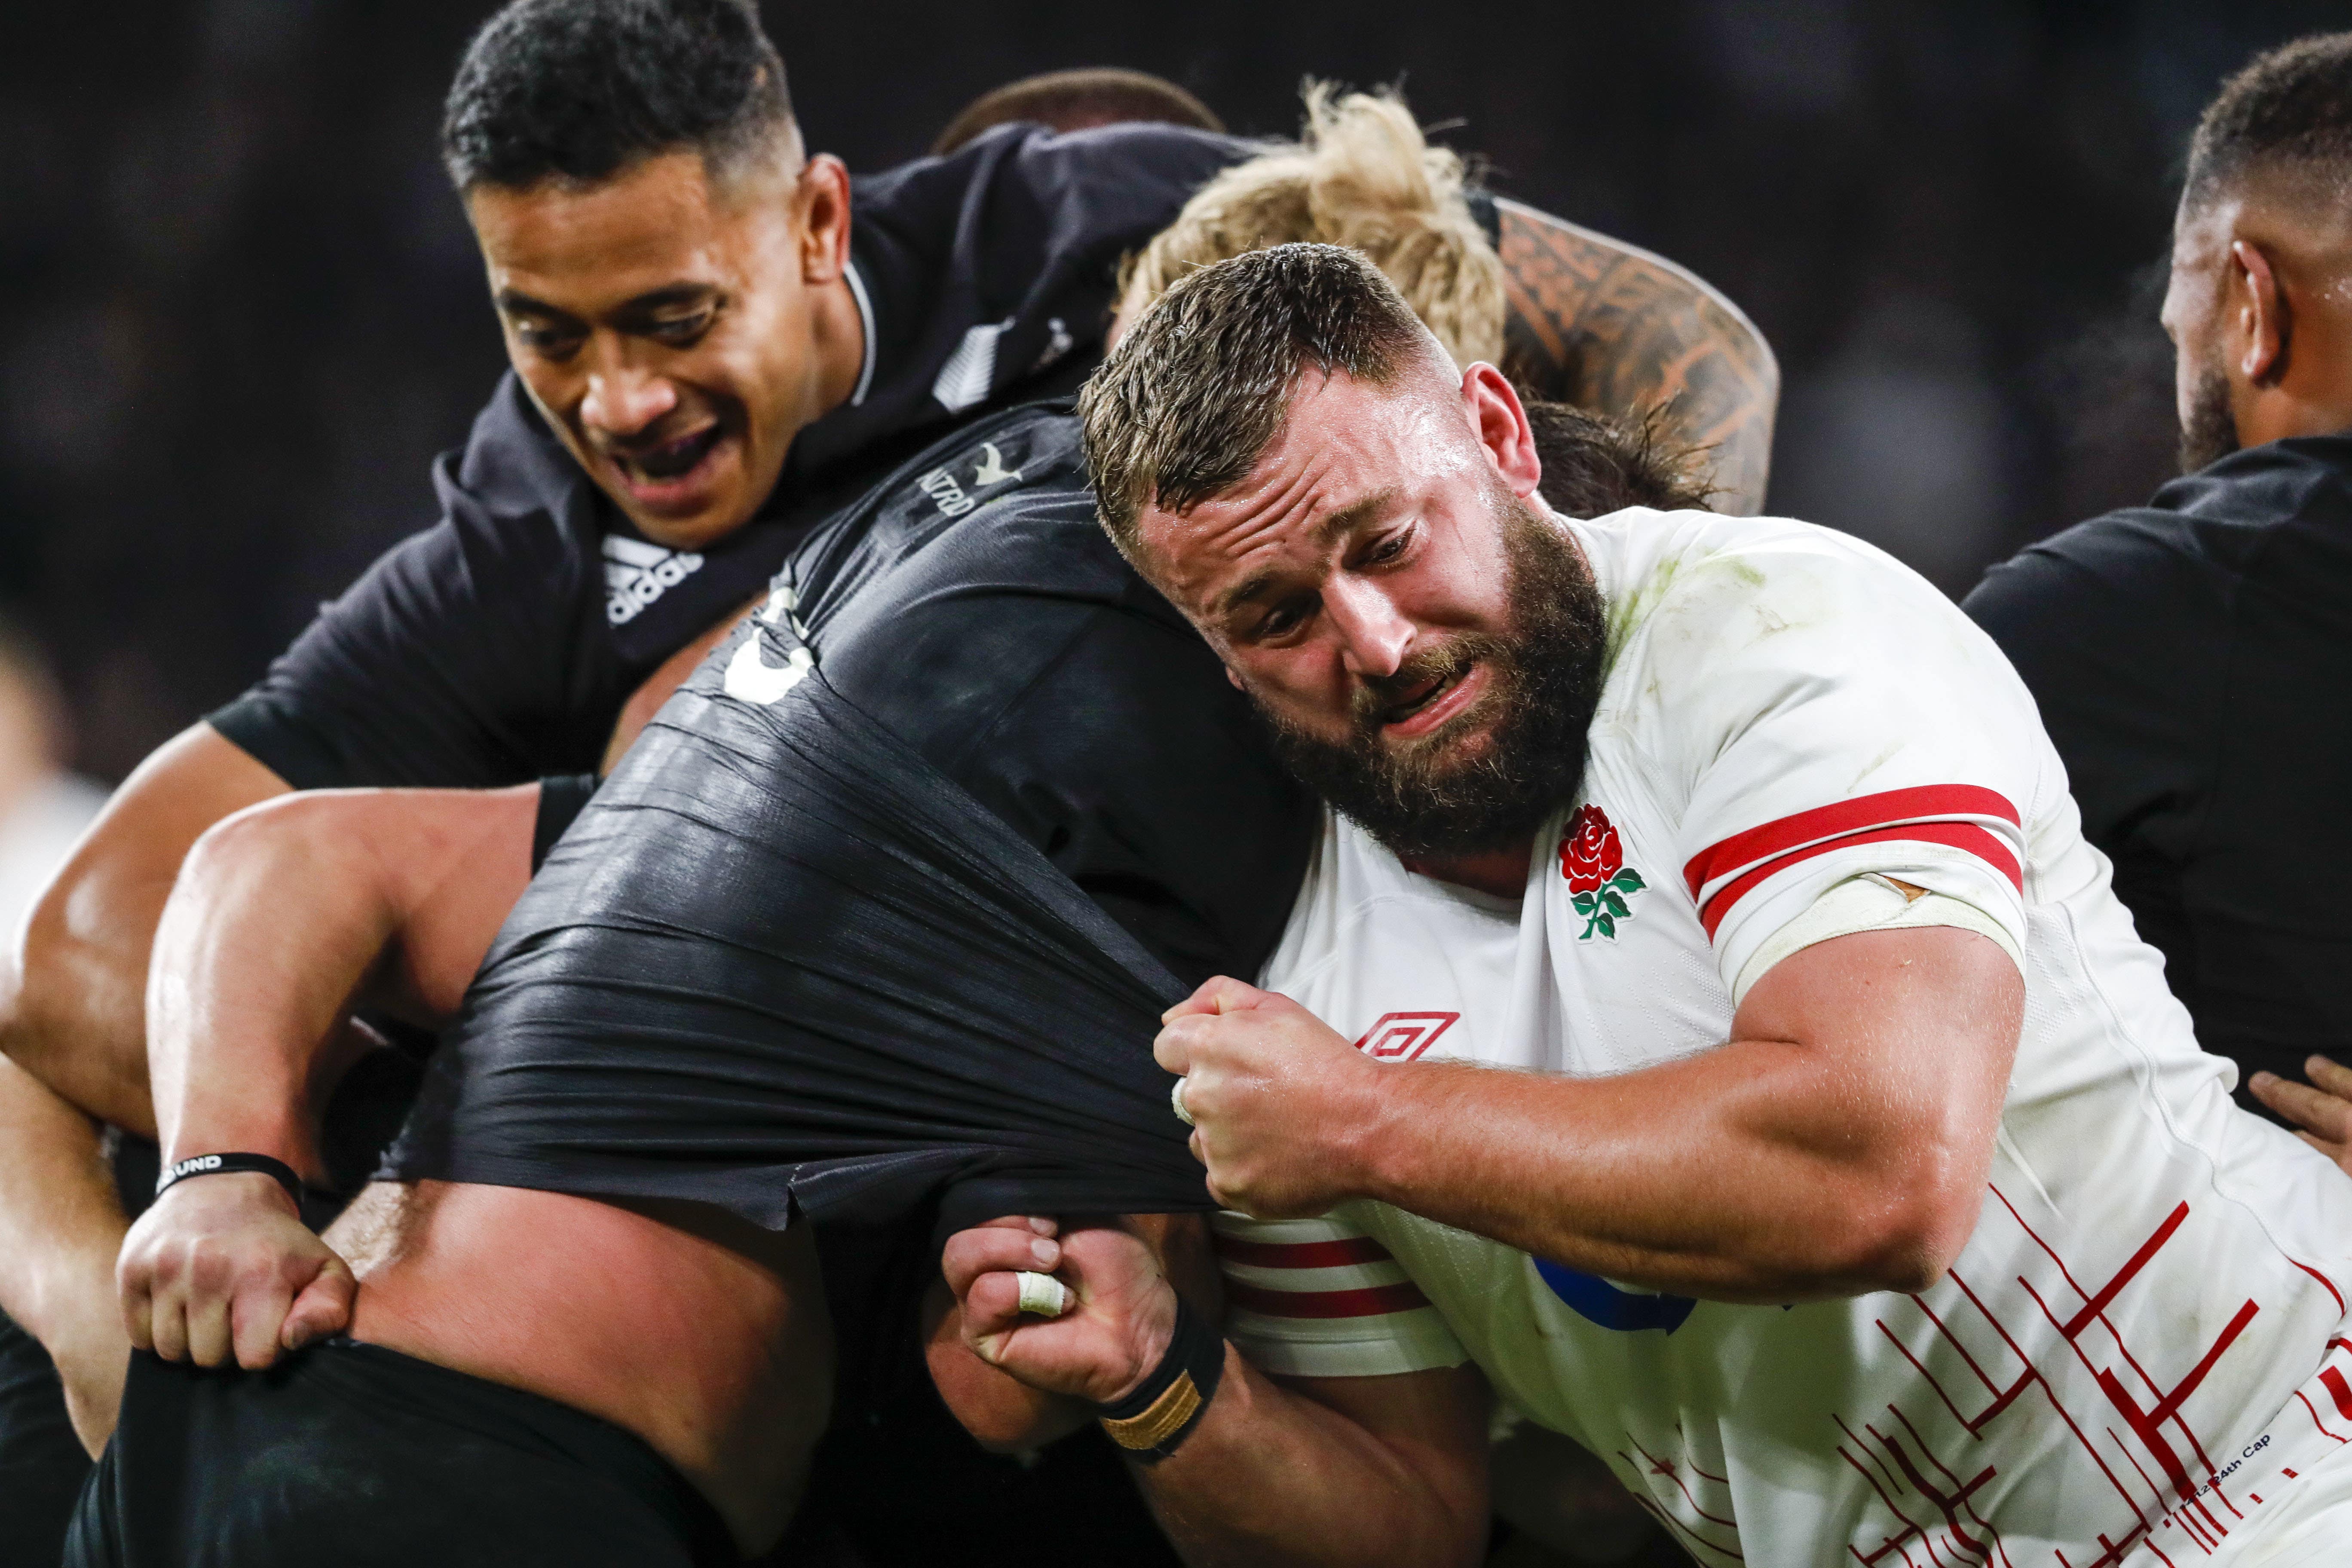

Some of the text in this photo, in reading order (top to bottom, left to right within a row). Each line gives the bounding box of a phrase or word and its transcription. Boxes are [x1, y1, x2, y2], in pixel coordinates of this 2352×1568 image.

[606, 551, 705, 628] didas
[2213, 1460, 2242, 1484] 24th
[2243, 1435, 2270, 1458] Cap
